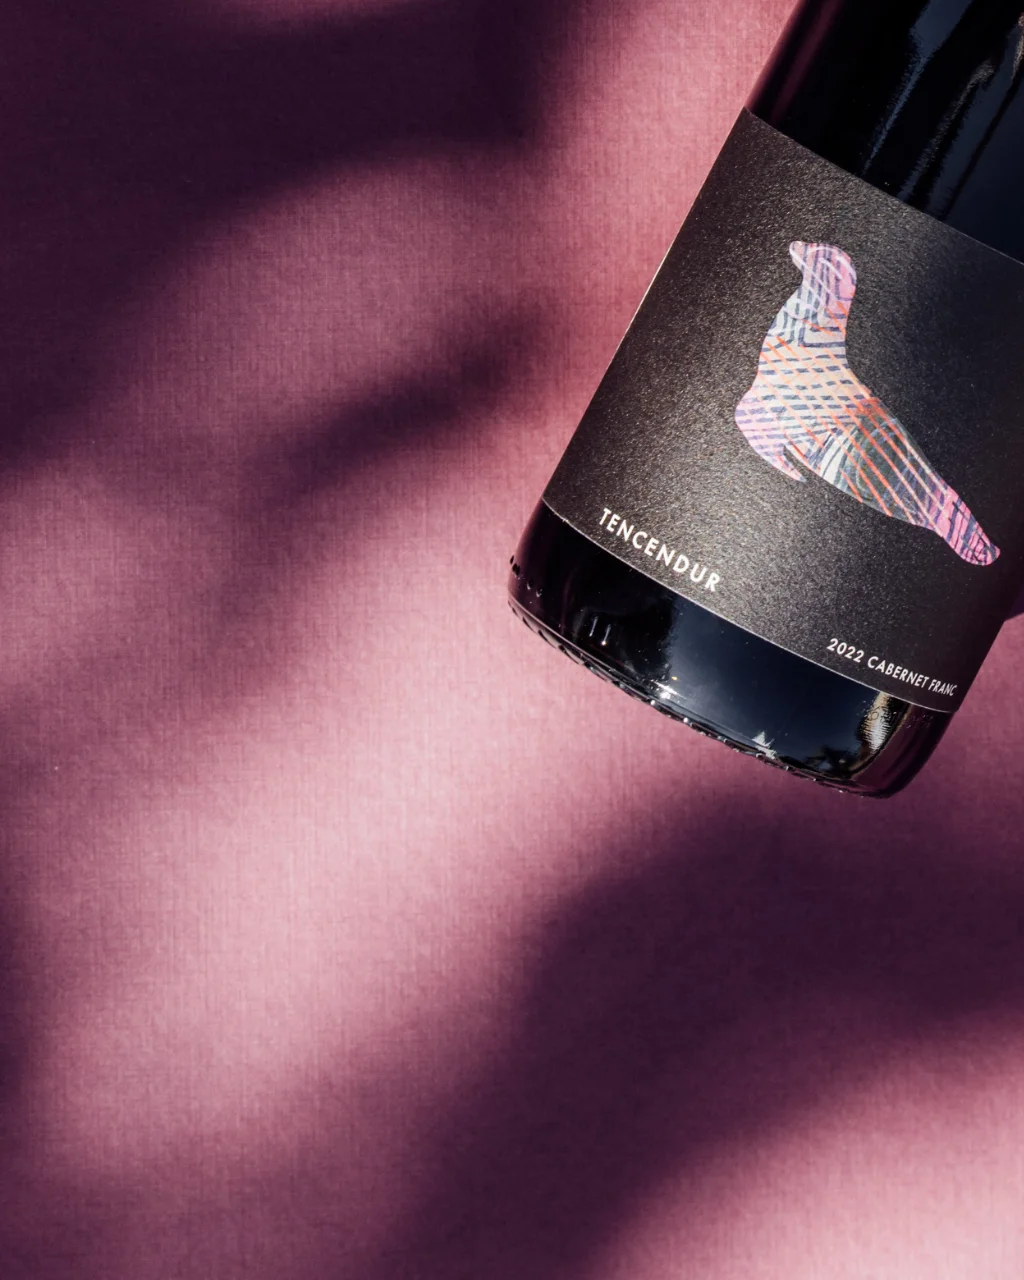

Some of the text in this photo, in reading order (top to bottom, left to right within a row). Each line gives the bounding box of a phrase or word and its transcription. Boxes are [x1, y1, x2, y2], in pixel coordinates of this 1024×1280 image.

[599, 508, 721, 591] TENCENDUR
[827, 638, 957, 696] 2022 CABERNET FRANC
